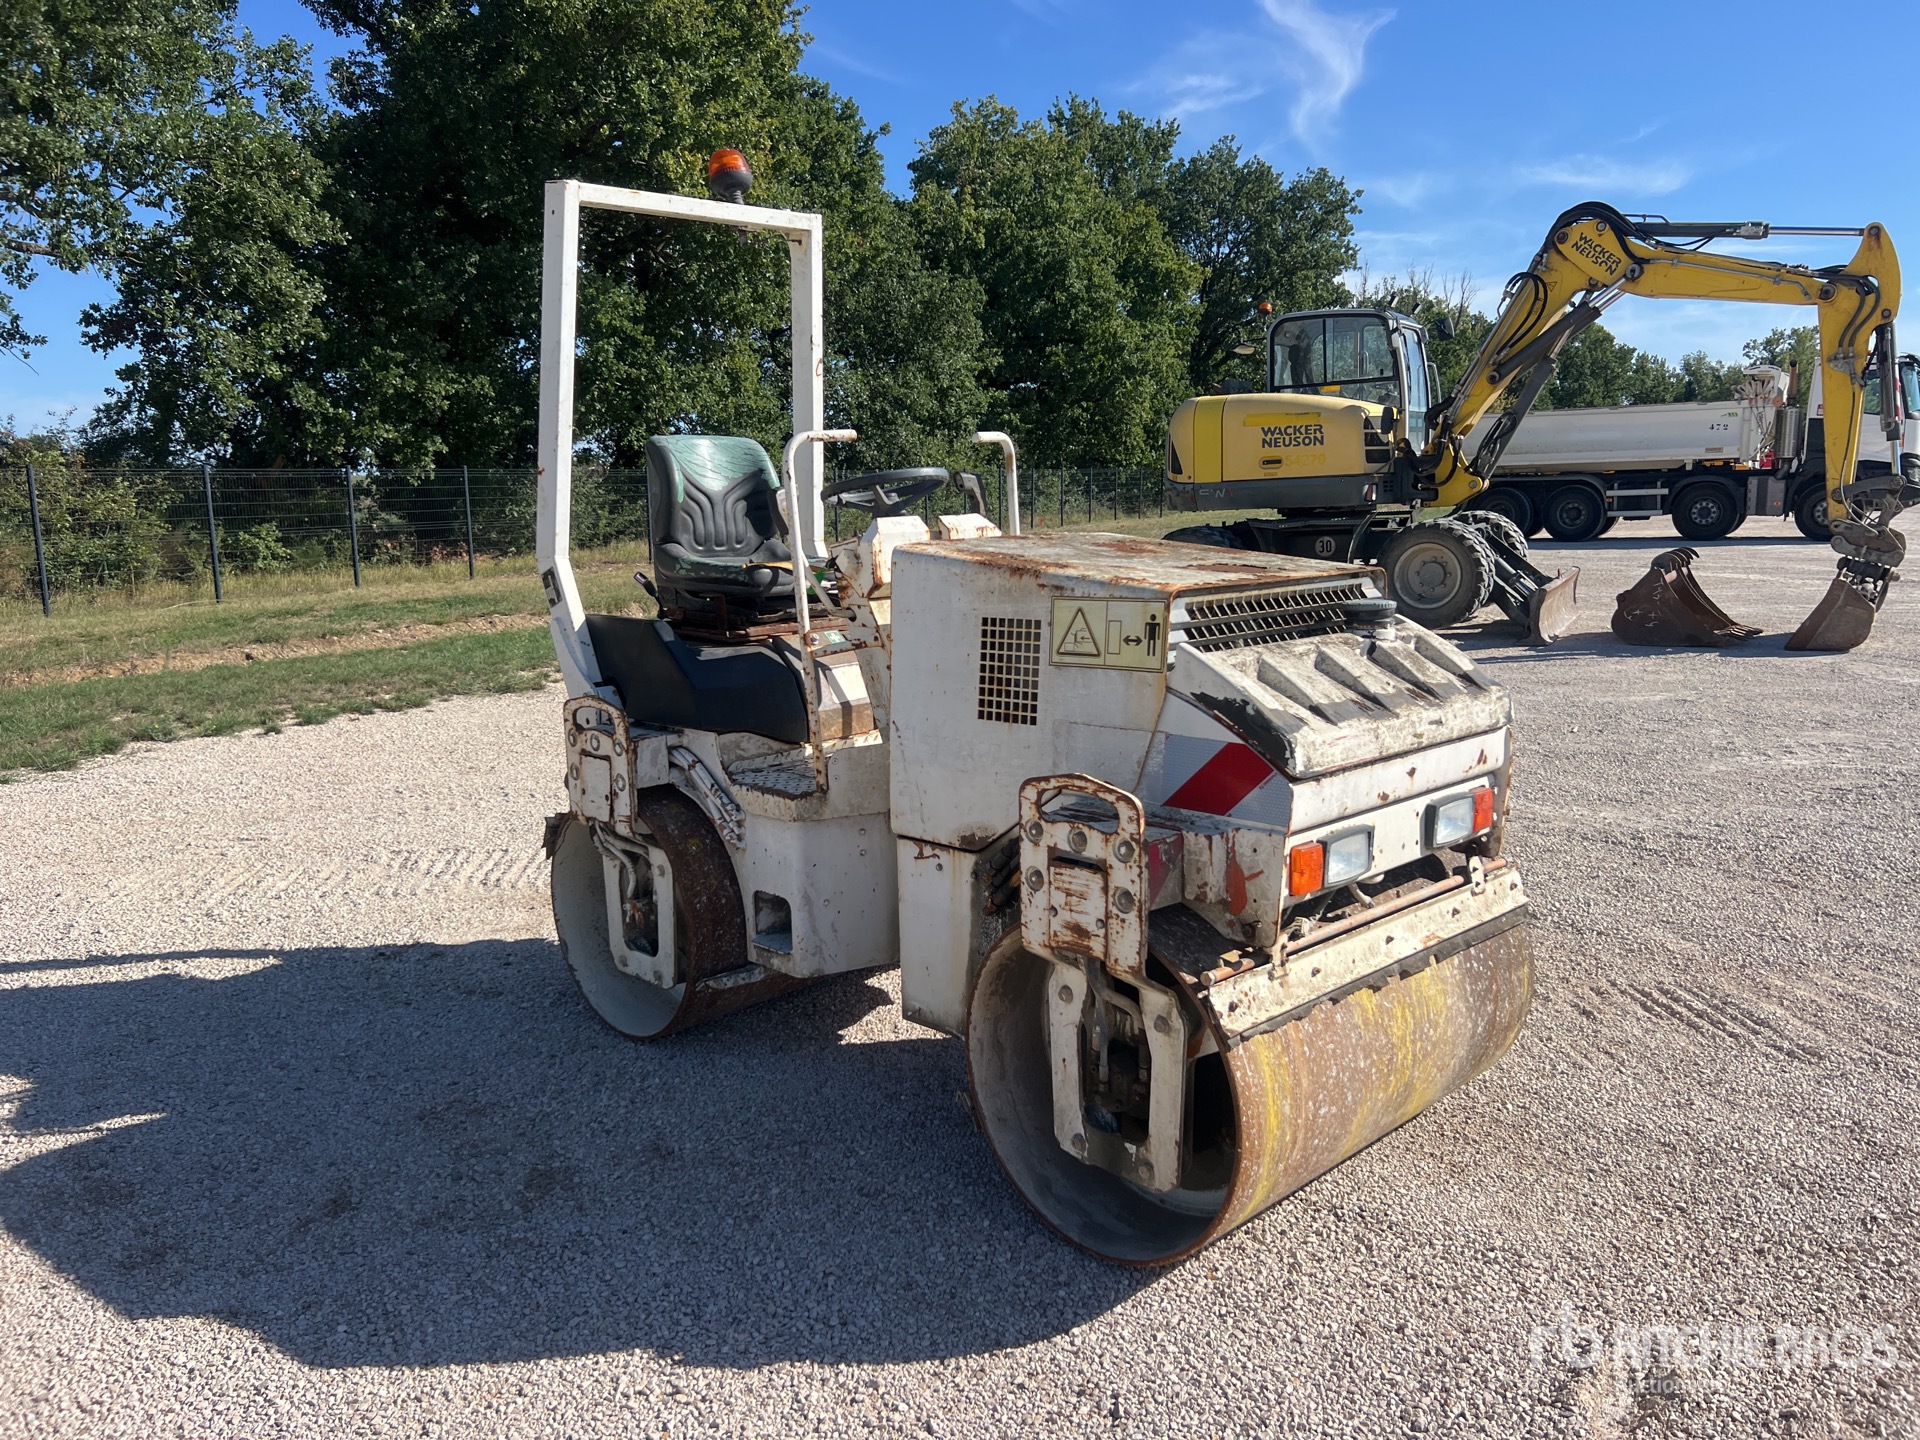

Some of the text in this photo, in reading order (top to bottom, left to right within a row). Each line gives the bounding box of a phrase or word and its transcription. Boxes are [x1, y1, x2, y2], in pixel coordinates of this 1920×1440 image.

[1579, 232, 1622, 268] WACKER
[1571, 241, 1618, 275] NEUSON
[1261, 424, 1324, 437] WACKER
[1709, 423, 1729, 431] 472
[1262, 435, 1324, 448] NEUSON
[1318, 540, 1332, 553] 30
